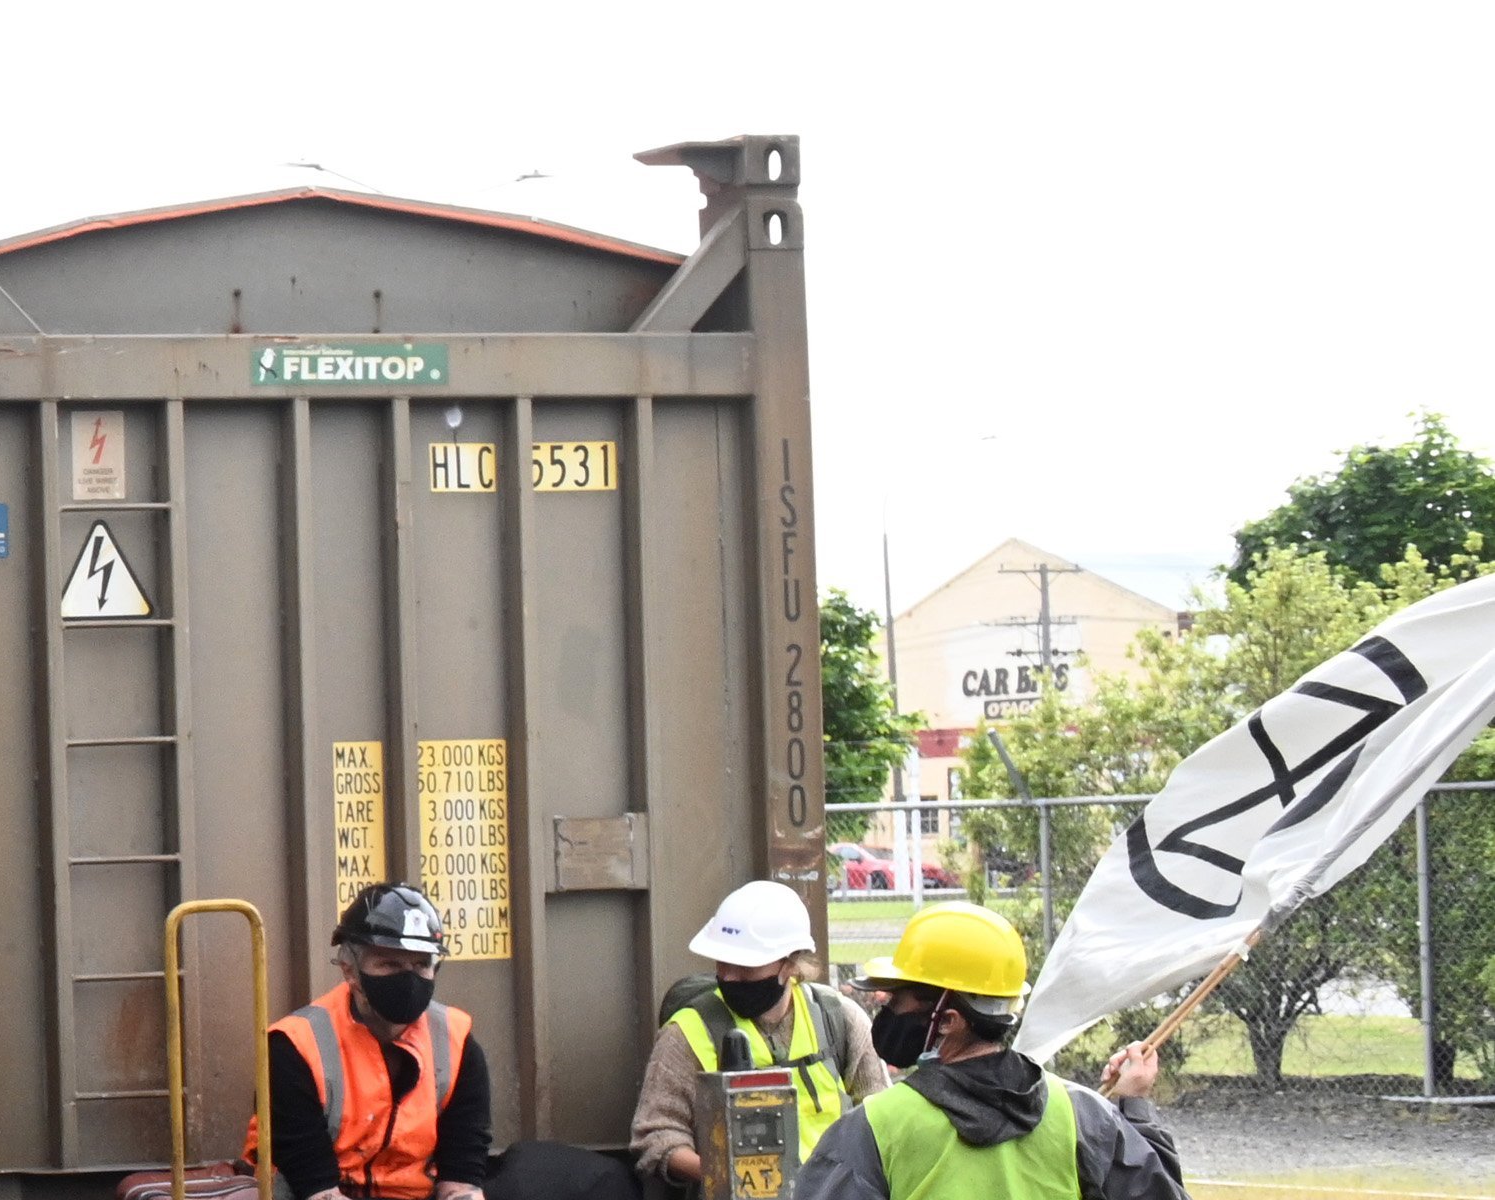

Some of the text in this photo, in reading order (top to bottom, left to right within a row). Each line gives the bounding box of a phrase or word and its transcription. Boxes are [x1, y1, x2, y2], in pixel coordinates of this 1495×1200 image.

[283, 356, 424, 380] FLEXITOP
[432, 446, 494, 489] HLC
[962, 668, 1009, 697] CAR
[335, 744, 504, 769] MAX. 23.000 KGS
[336, 772, 381, 794] GROSS
[479, 770, 504, 792] LBS
[337, 799, 505, 823] TARE 3.000 KGS
[337, 824, 505, 849] WGT. 6.610 LBS
[338, 853, 506, 877] MAX. 20.000 KGS
[481, 879, 507, 901] LBS
[477, 907, 508, 929] CU.M
[472, 933, 508, 955] CU.FT
[742, 1168, 773, 1190] AT
